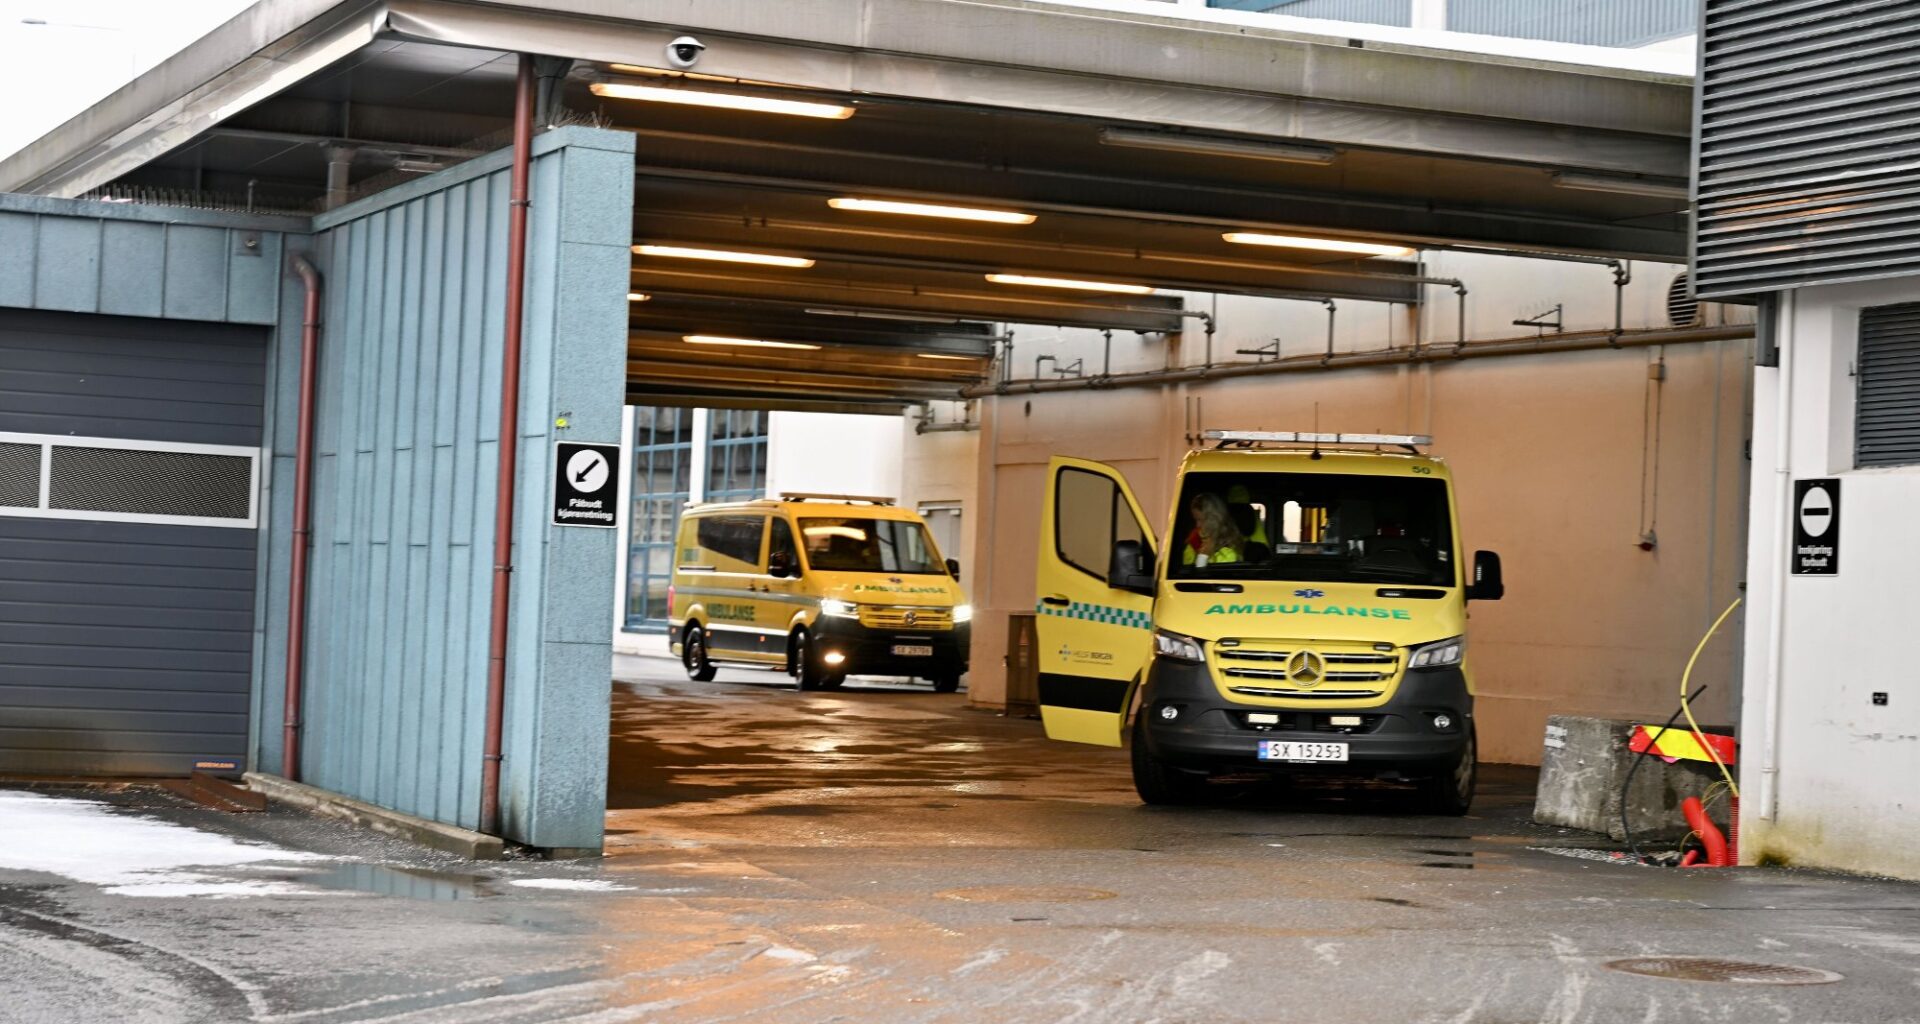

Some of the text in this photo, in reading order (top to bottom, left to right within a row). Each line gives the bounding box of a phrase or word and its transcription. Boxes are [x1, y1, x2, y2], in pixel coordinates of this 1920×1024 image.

[1411, 465, 1431, 475] 50
[569, 499, 602, 508] Påbudt
[854, 584, 948, 594] AMBULANSE
[706, 603, 755, 621] AMBULANSE
[1204, 604, 1412, 621] AMBULANSE
[1272, 743, 1342, 759] SX 15253
